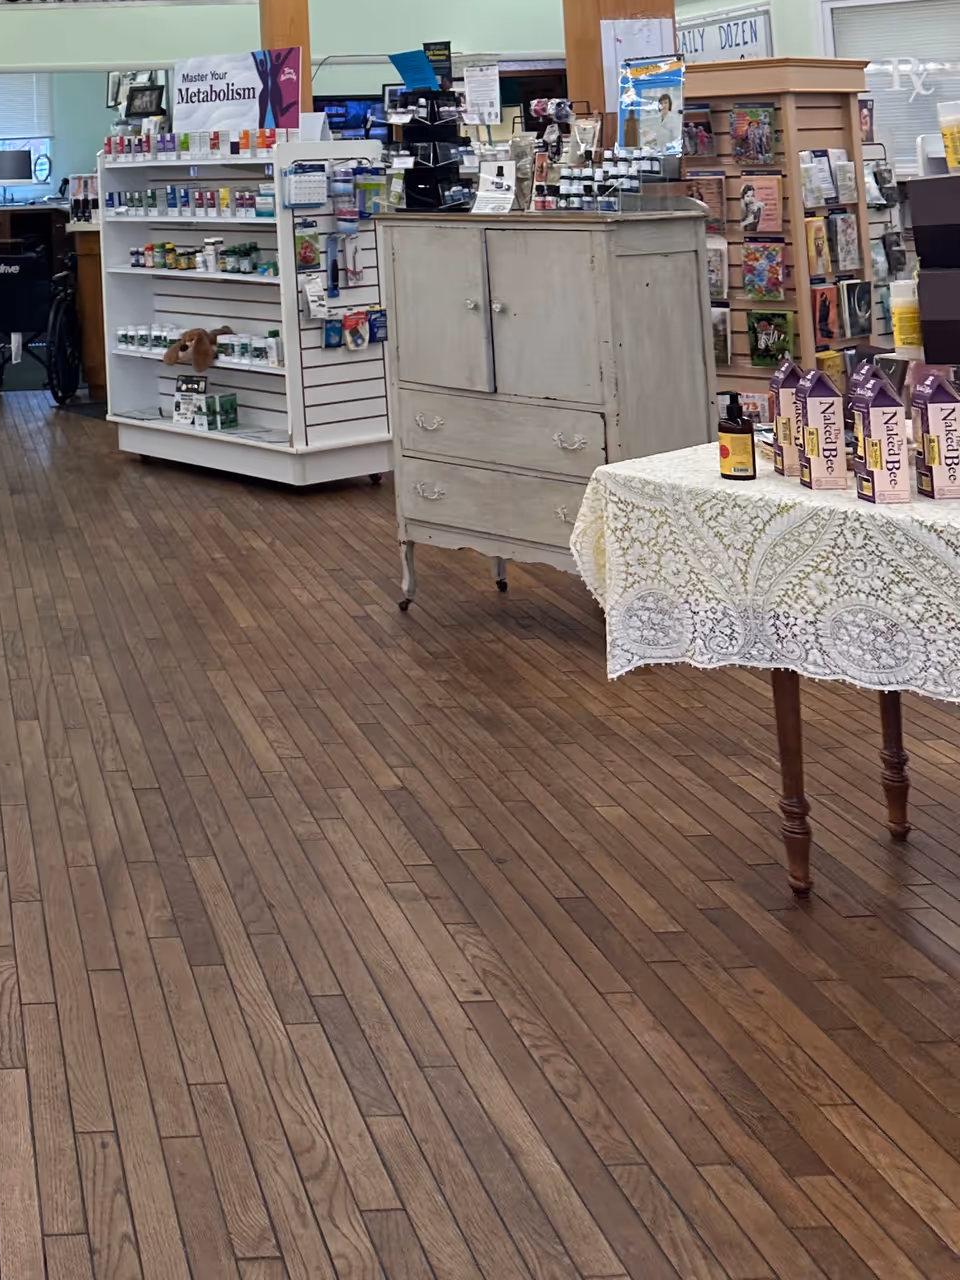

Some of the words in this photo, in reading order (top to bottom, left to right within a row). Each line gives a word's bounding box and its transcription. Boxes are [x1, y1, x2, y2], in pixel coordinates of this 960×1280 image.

[718, 19, 758, 50] DOZEN
[182, 73, 208, 83] Master
[210, 70, 228, 80] Your
[177, 83, 256, 104] Metabolism
[819, 400, 837, 445] Naked
[882, 411, 900, 457] Naked
[940, 407, 958, 453] Naked
[822, 447, 838, 474] Bee
[885, 459, 901, 487] Bee
